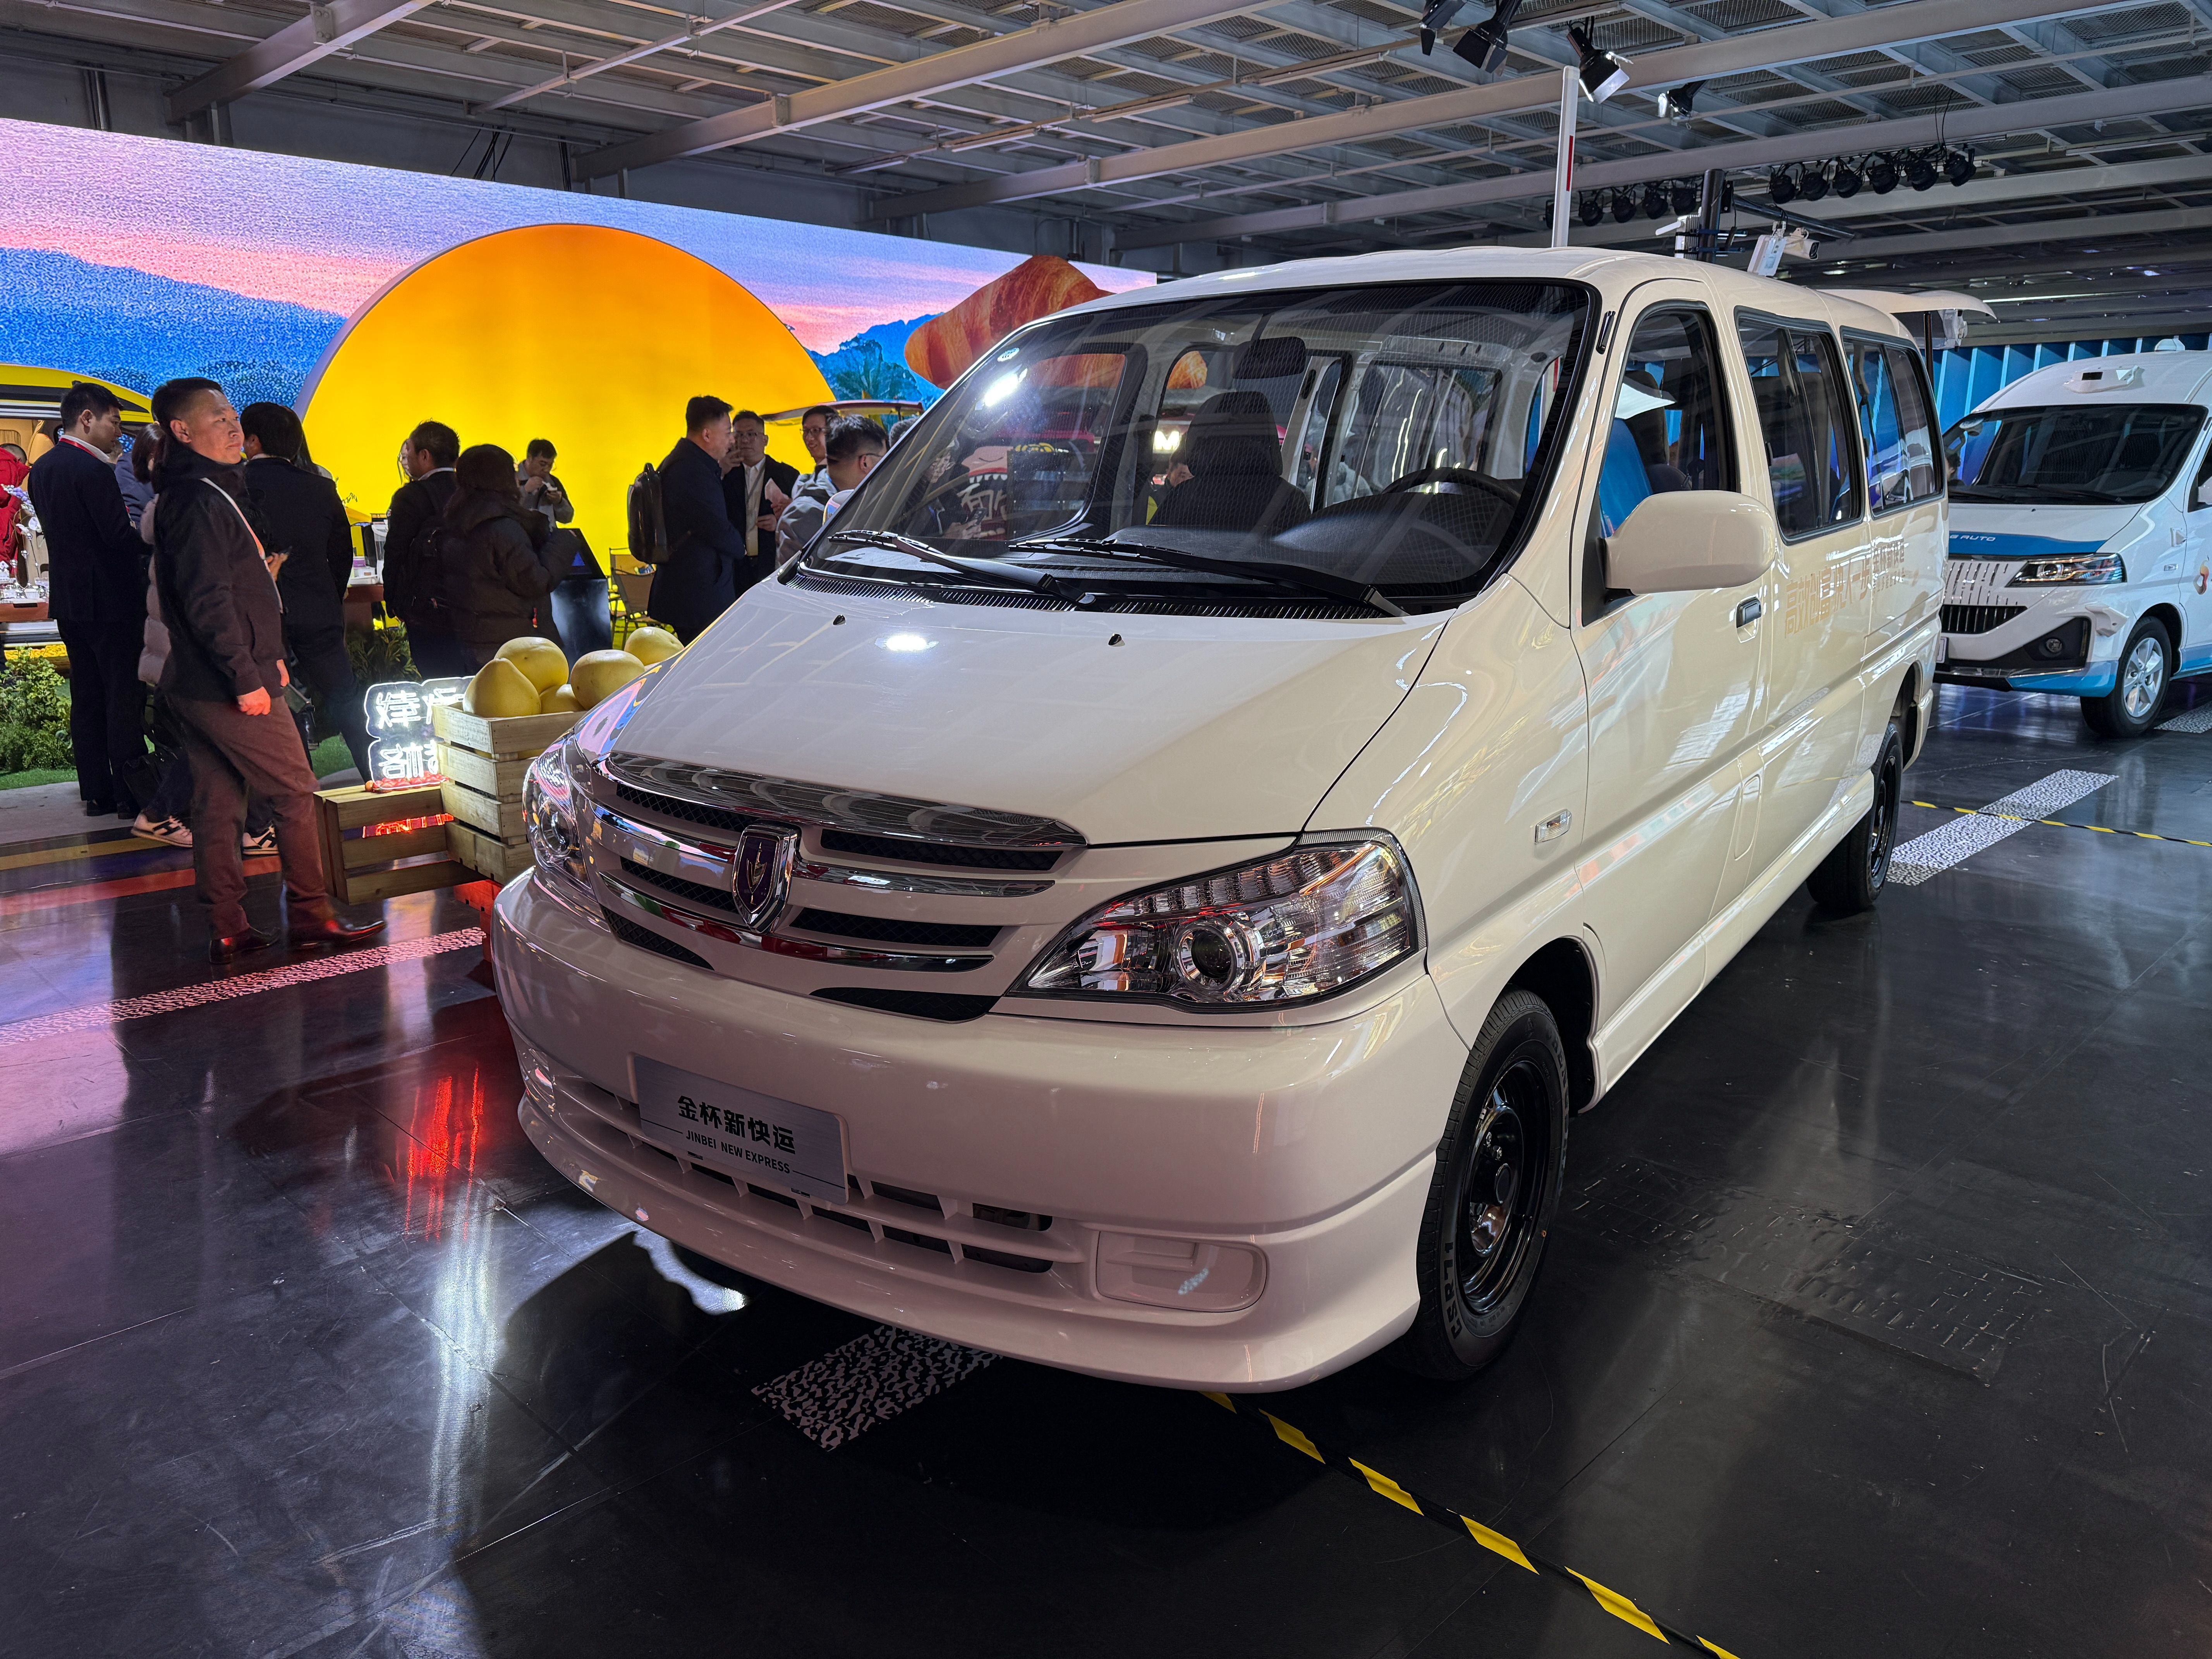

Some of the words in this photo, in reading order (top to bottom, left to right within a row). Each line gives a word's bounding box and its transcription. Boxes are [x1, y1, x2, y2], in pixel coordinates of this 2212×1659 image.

[677, 1095, 796, 1154] 金杯新快运
[686, 1130, 716, 1149] JINBEI
[721, 1142, 743, 1159] NEW
[745, 1150, 790, 1174] EXPRESS
[1444, 1242, 1463, 1340] CSR71
